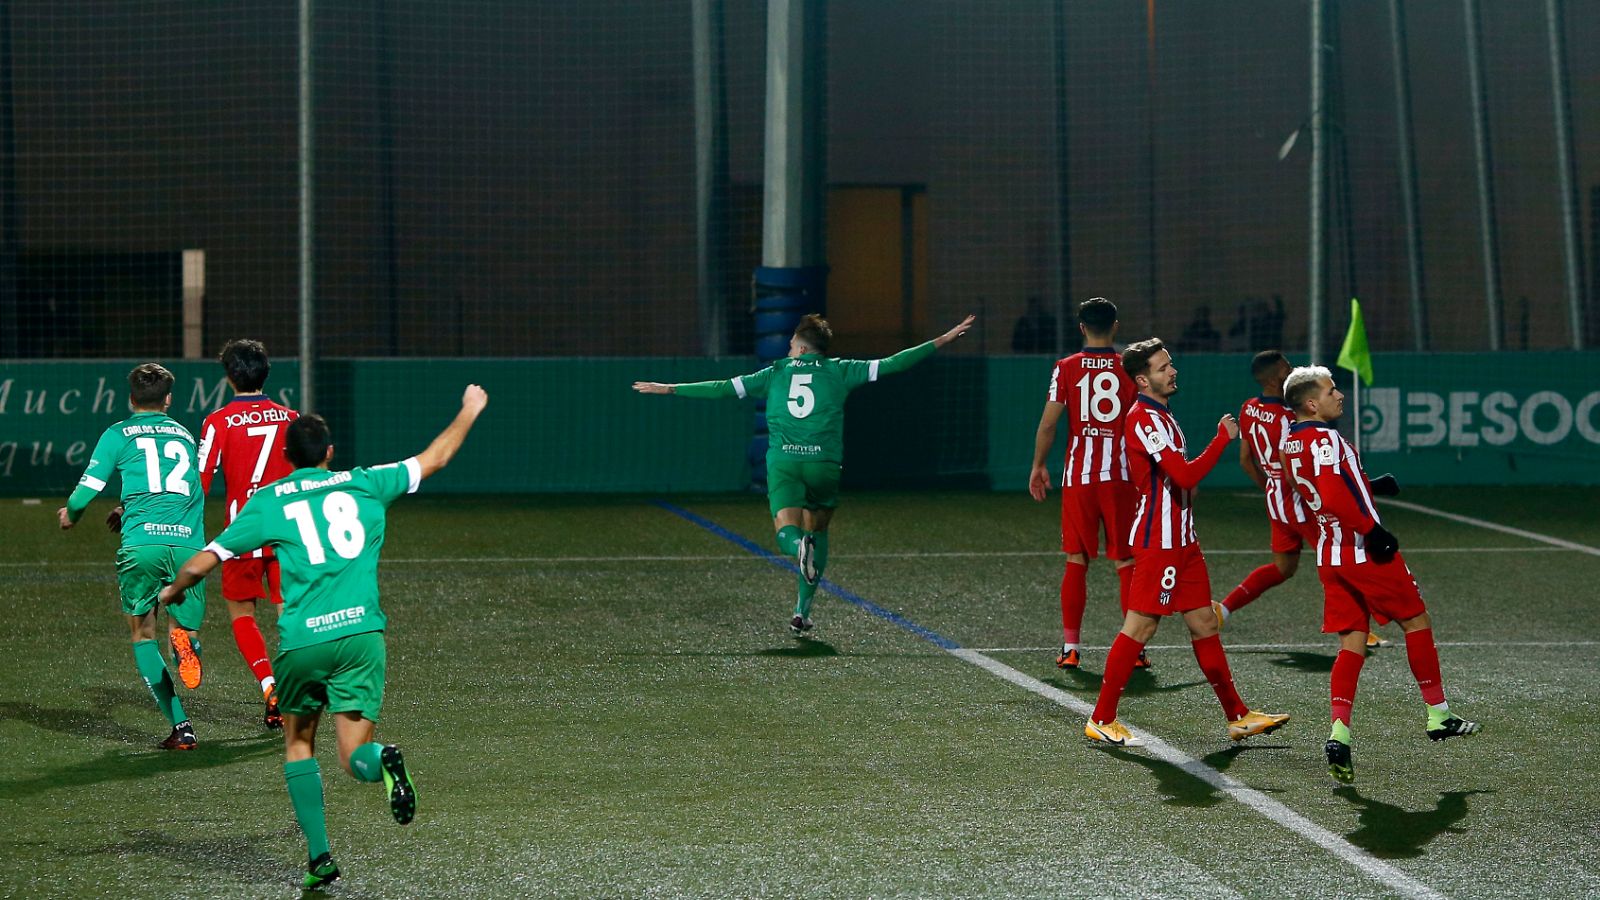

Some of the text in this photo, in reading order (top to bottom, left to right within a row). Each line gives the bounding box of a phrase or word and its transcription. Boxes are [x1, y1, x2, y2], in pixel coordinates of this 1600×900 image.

[1081, 358, 1114, 369] FELIPE
[787, 374, 815, 418] 5
[1076, 371, 1121, 423] 18
[225, 408, 290, 428] JOÃO FÉLIX
[1082, 423, 1099, 436] ria
[247, 424, 278, 483] 7
[1248, 421, 1282, 469] 12
[136, 437, 190, 496] 12
[274, 471, 353, 497] POL MORENO
[1291, 457, 1322, 511] 5
[144, 523, 192, 535] ENINTER
[283, 491, 366, 565] 18
[1161, 566, 1177, 590] 8
[306, 606, 365, 628] ENINTER
